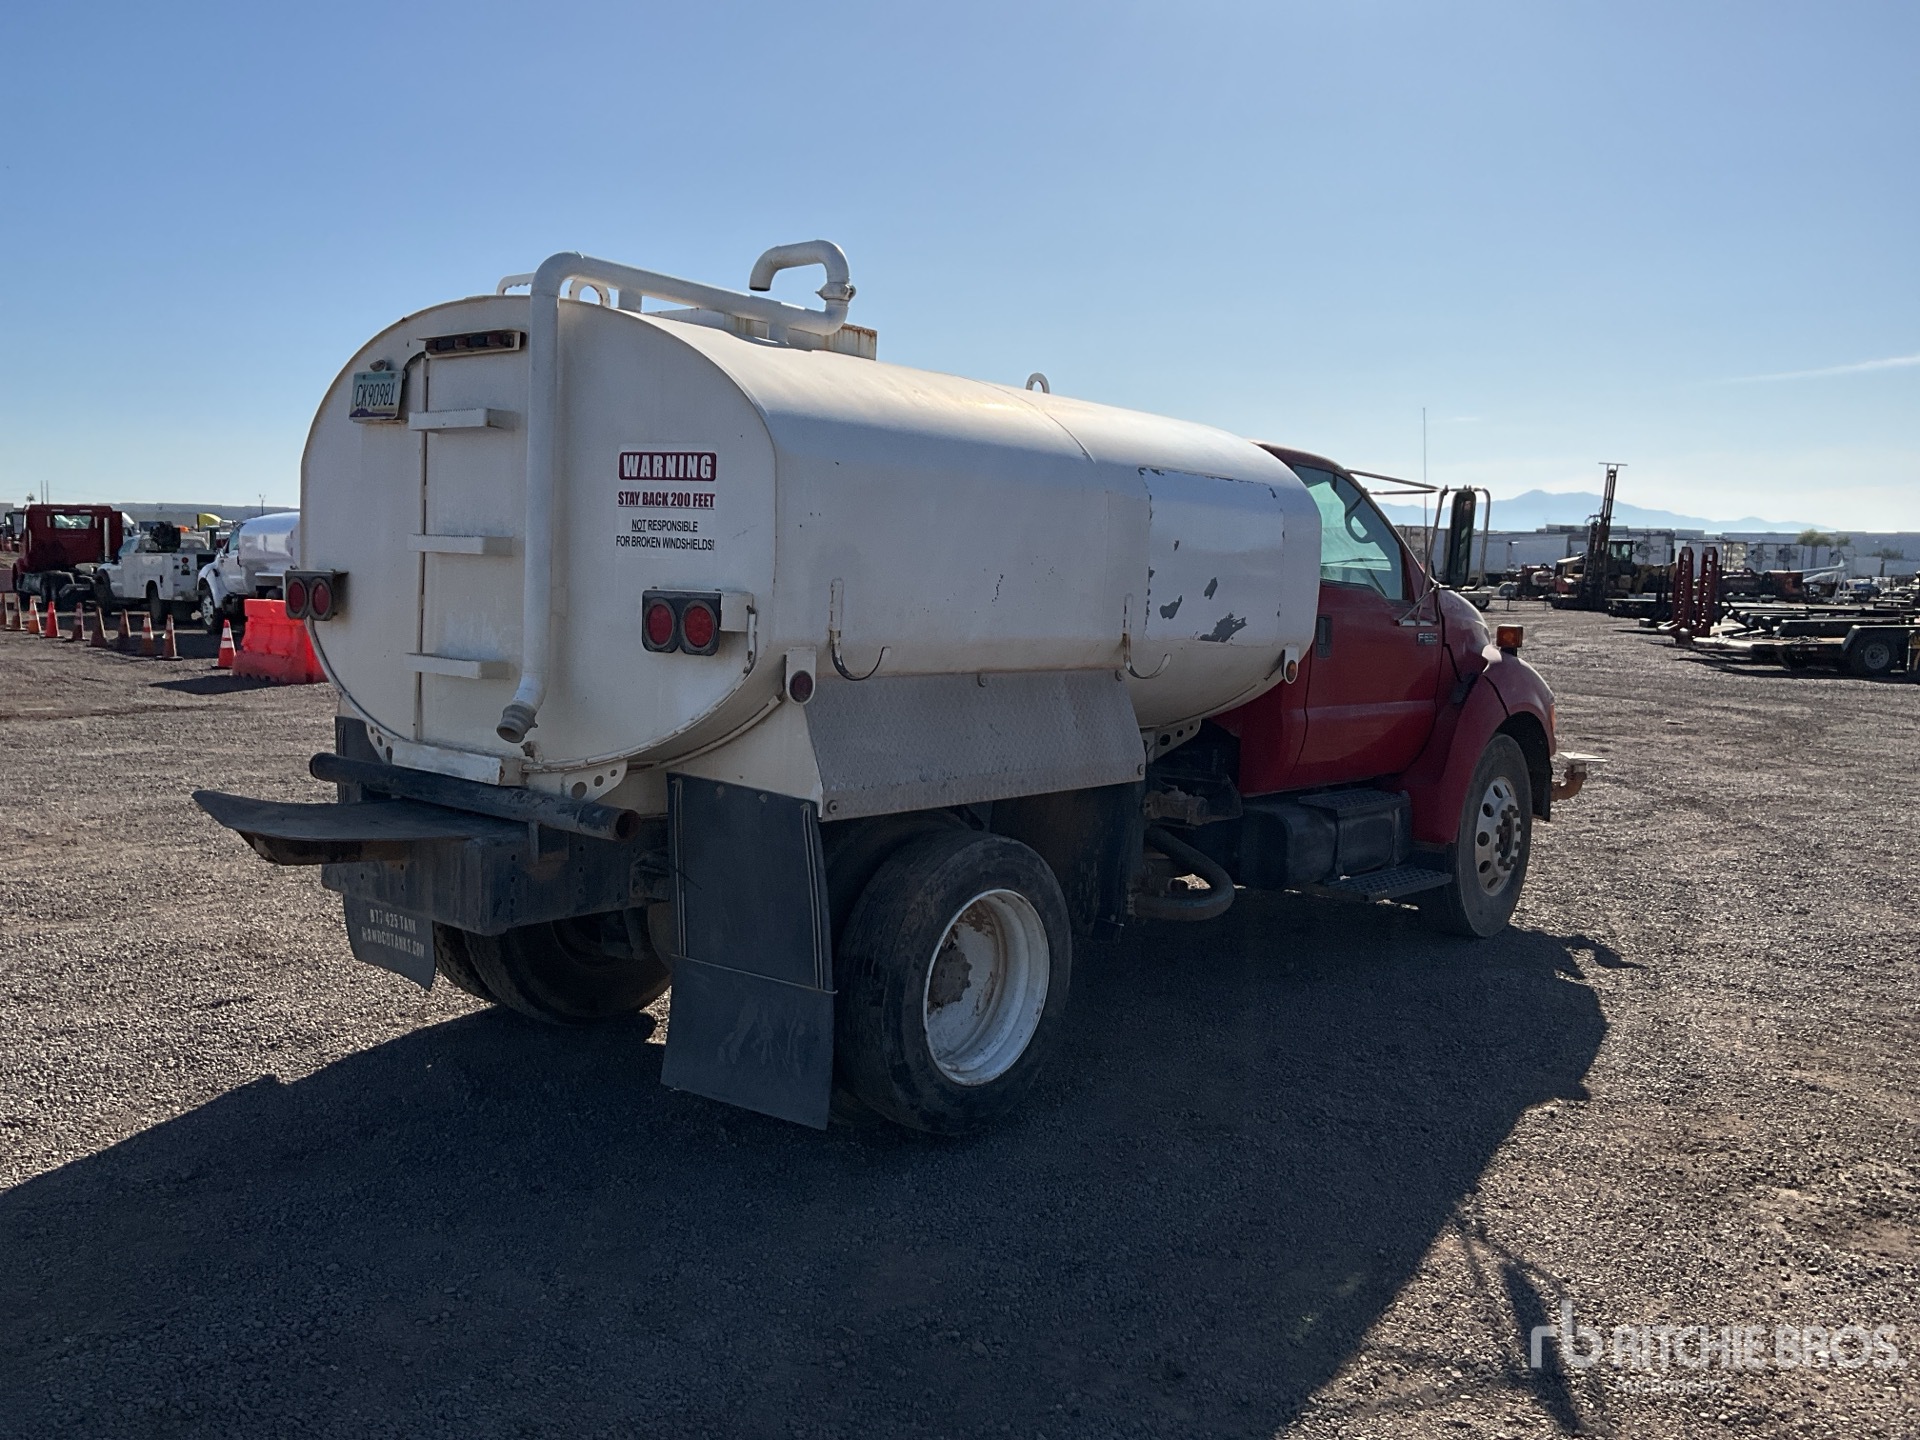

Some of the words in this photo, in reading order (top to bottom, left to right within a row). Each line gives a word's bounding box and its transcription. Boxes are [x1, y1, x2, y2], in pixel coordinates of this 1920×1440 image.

[623, 454, 712, 479] WARNING
[618, 491, 640, 506] STAY
[642, 492, 669, 506] BACK
[670, 492, 691, 507] 200
[693, 493, 715, 508] FEET
[631, 519, 647, 532] NOT
[648, 520, 698, 532] RESPONSIBLE
[616, 535, 631, 547] FOR
[631, 536, 661, 548] BROKEN
[662, 538, 715, 551] WINDSHIELDS!
